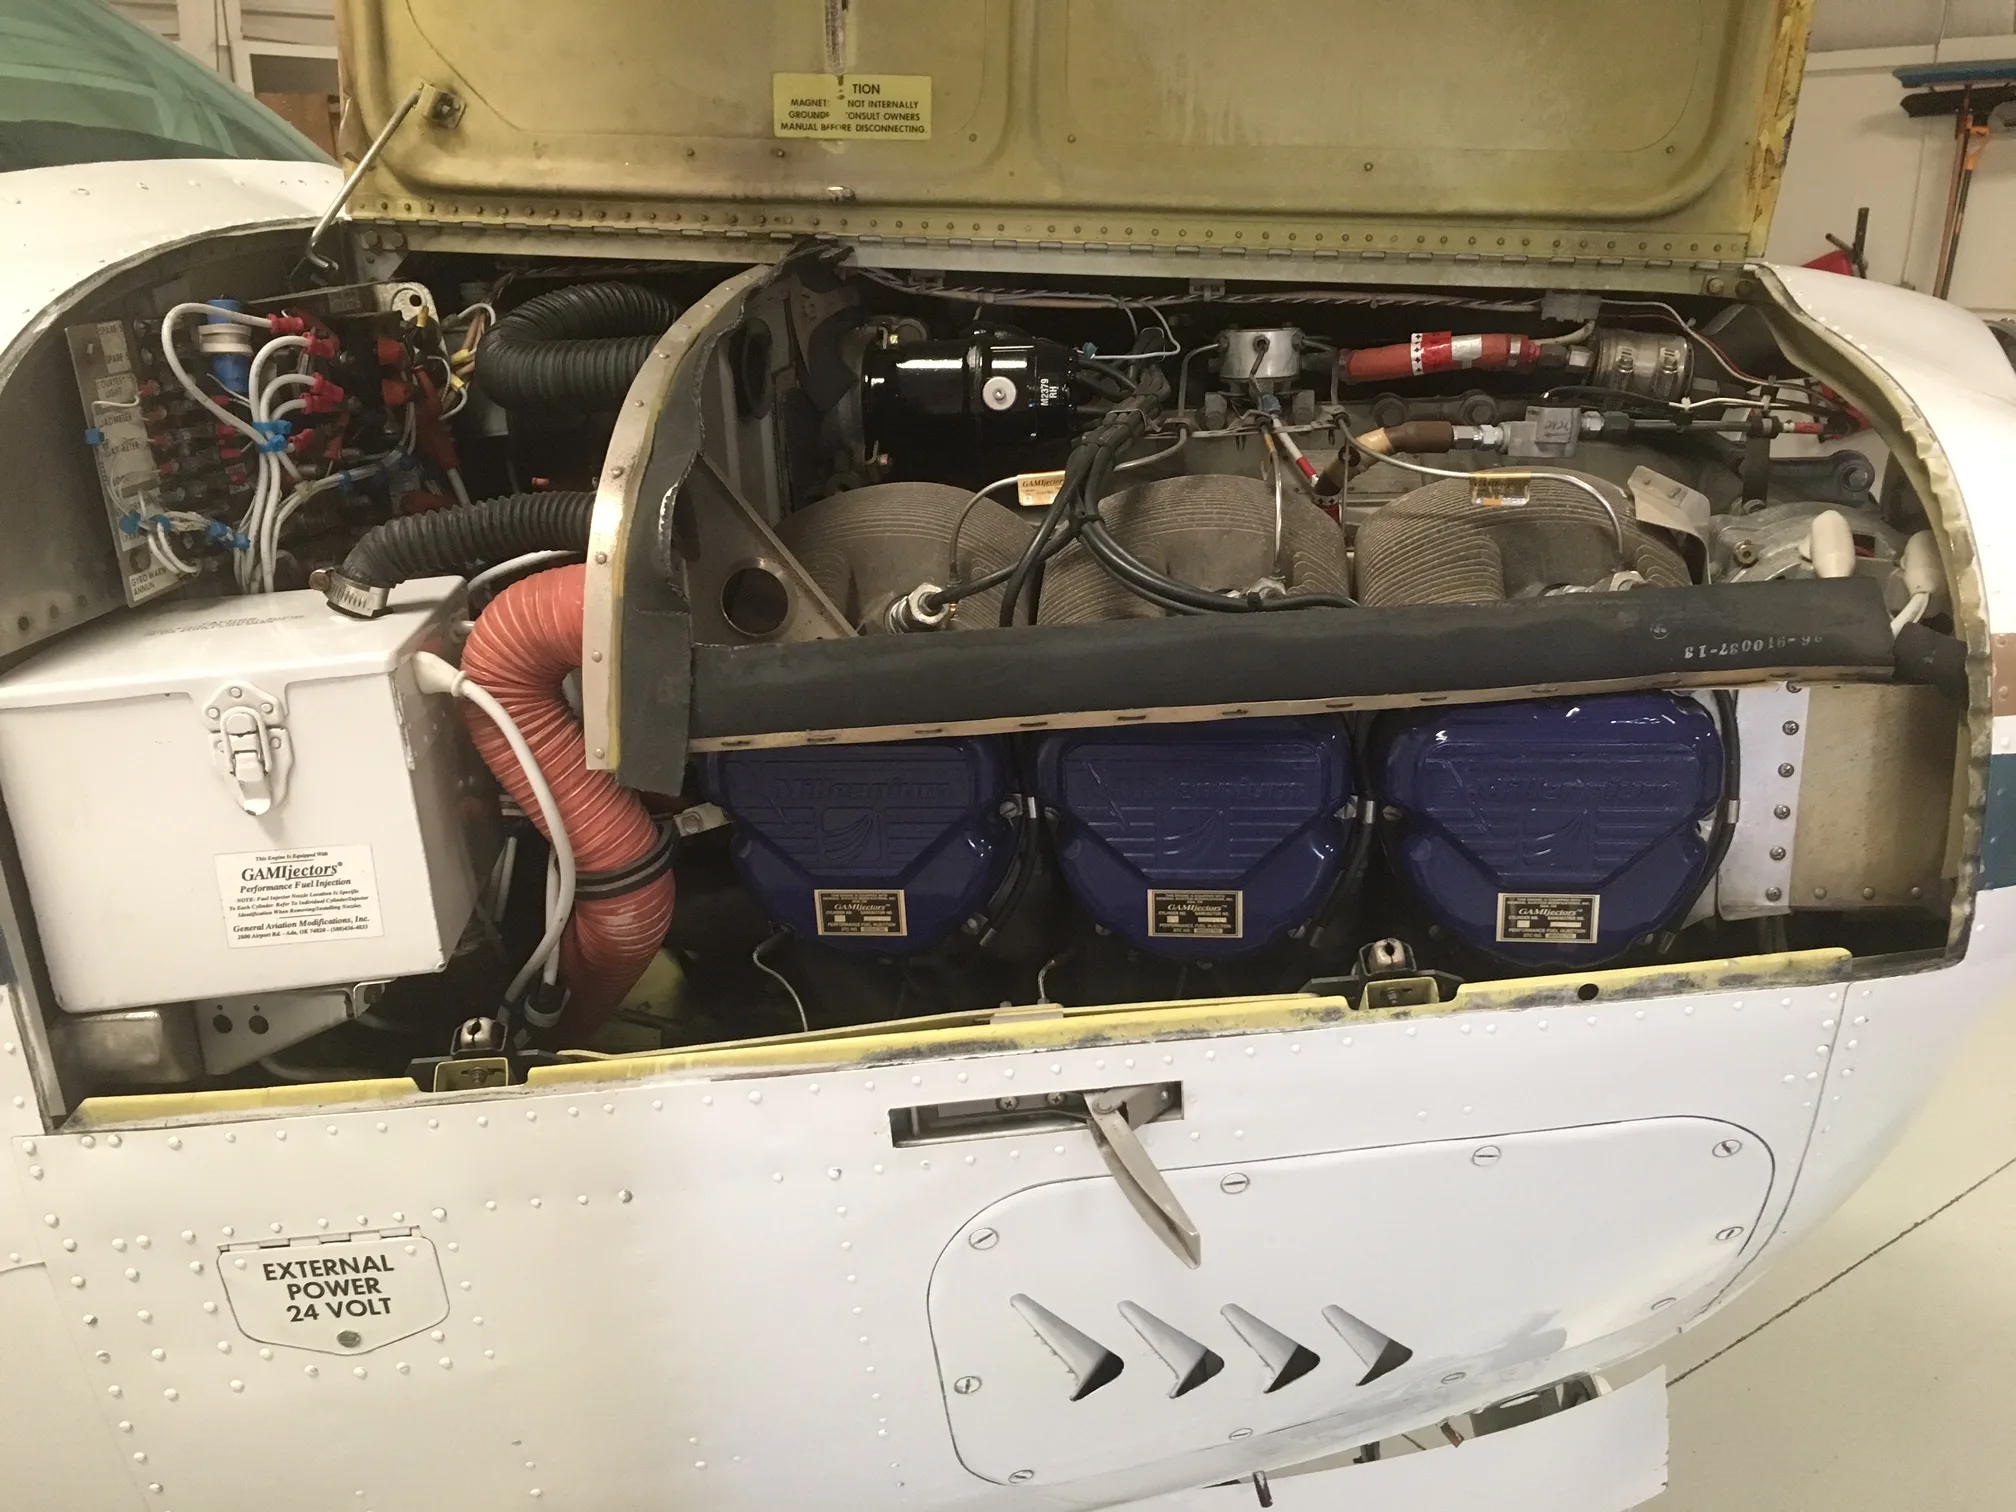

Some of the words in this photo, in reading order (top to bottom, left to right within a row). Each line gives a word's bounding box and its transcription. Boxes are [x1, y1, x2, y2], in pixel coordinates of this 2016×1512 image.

[852, 83, 880, 95] TION
[791, 98, 828, 107] MAGNET
[848, 99, 865, 108] NOT
[868, 100, 919, 109] INTERNALLY
[846, 111, 880, 120] ONSULT
[883, 112, 921, 121] OWNERS
[780, 122, 818, 131] MANUAL
[1040, 378, 1049, 406] M2379
[1049, 386, 1057, 398] RH
[1022, 479, 1064, 488] GAMIjector
[131, 574, 148, 587] GYRO
[133, 582, 156, 596] ANNUN
[240, 884, 293, 894] Performance
[294, 880, 314, 889] Fuel
[315, 878, 351, 888] Injection
[233, 923, 264, 932] General
[265, 921, 297, 930] Aviation
[299, 917, 353, 927] Modifications,
[262, 1254, 395, 1281] EXTERNAL
[286, 1277, 382, 1301] POWER
[286, 1304, 320, 1322] 24
[325, 1297, 392, 1319] VOLT
